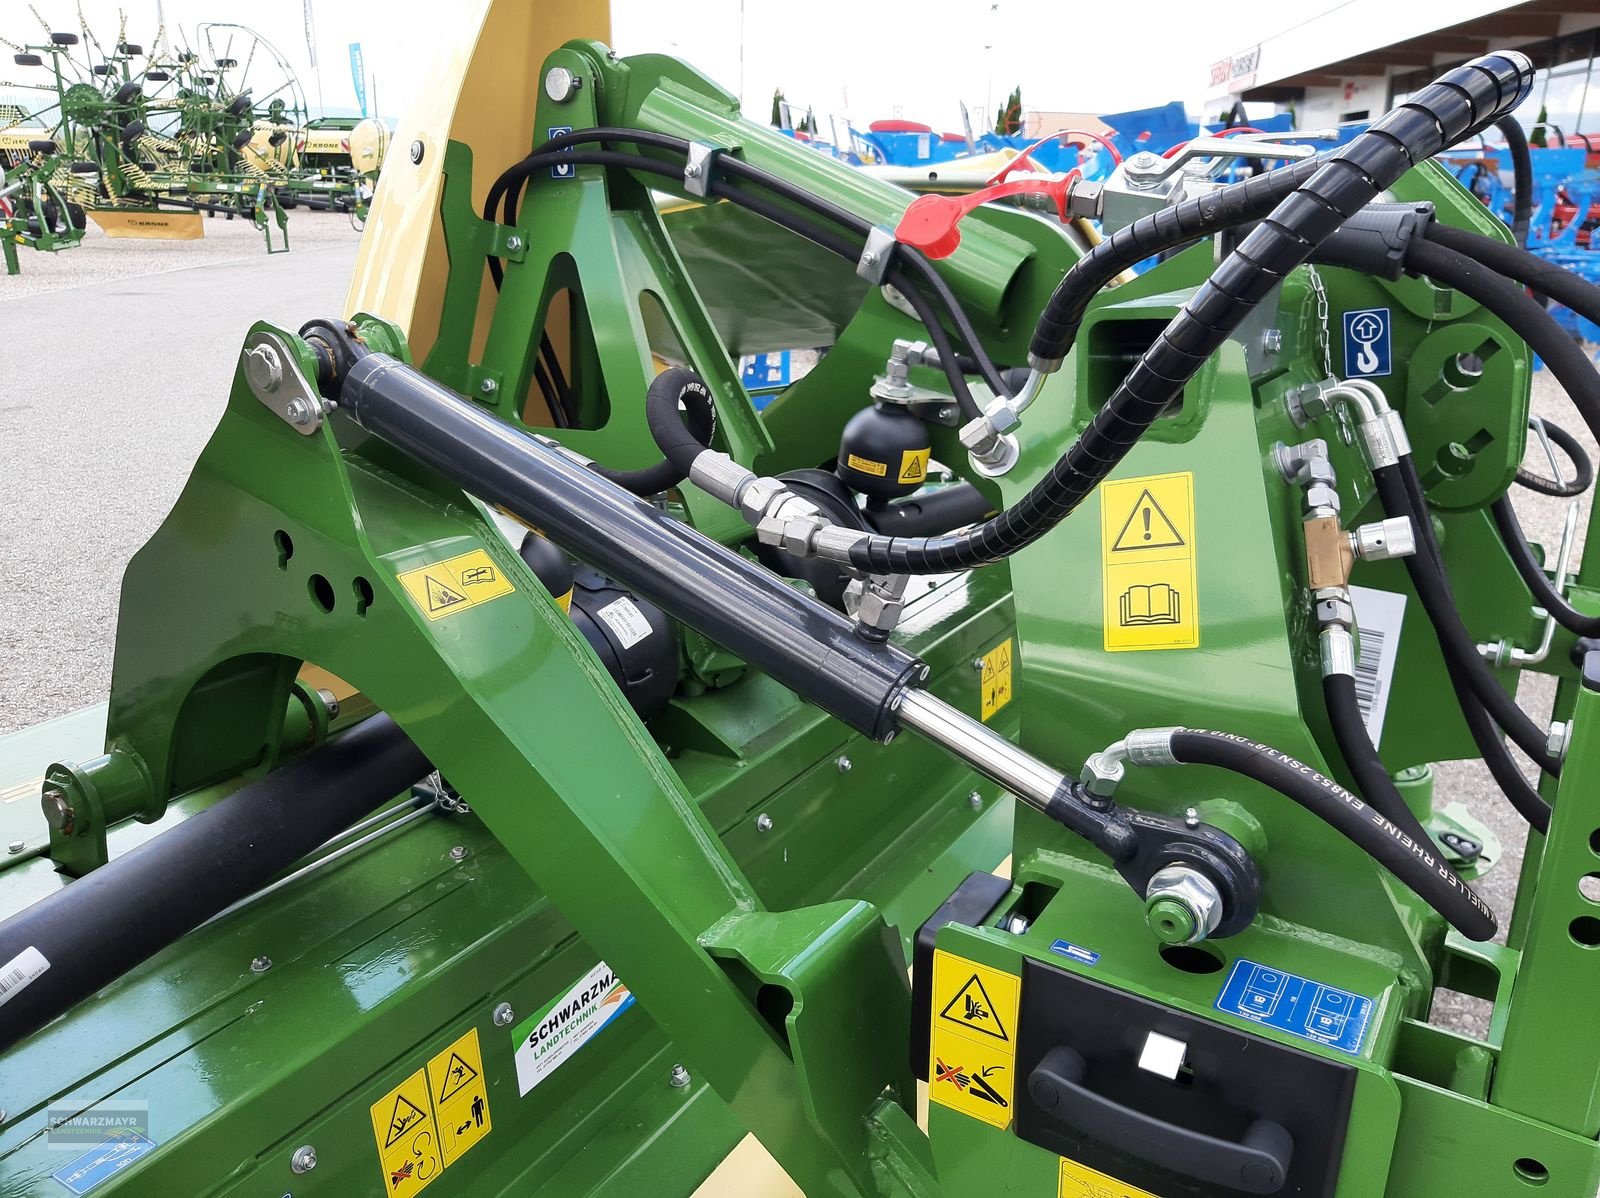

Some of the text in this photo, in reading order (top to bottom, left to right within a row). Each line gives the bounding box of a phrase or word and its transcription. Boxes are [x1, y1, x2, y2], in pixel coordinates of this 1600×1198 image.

[1279, 754, 1312, 774] 2SN
[1312, 773, 1365, 810] EN853
[1371, 812, 1435, 868] RHEINE
[1438, 863, 1490, 918] MUELLER
[533, 1003, 598, 1060] LANDTECHNIK
